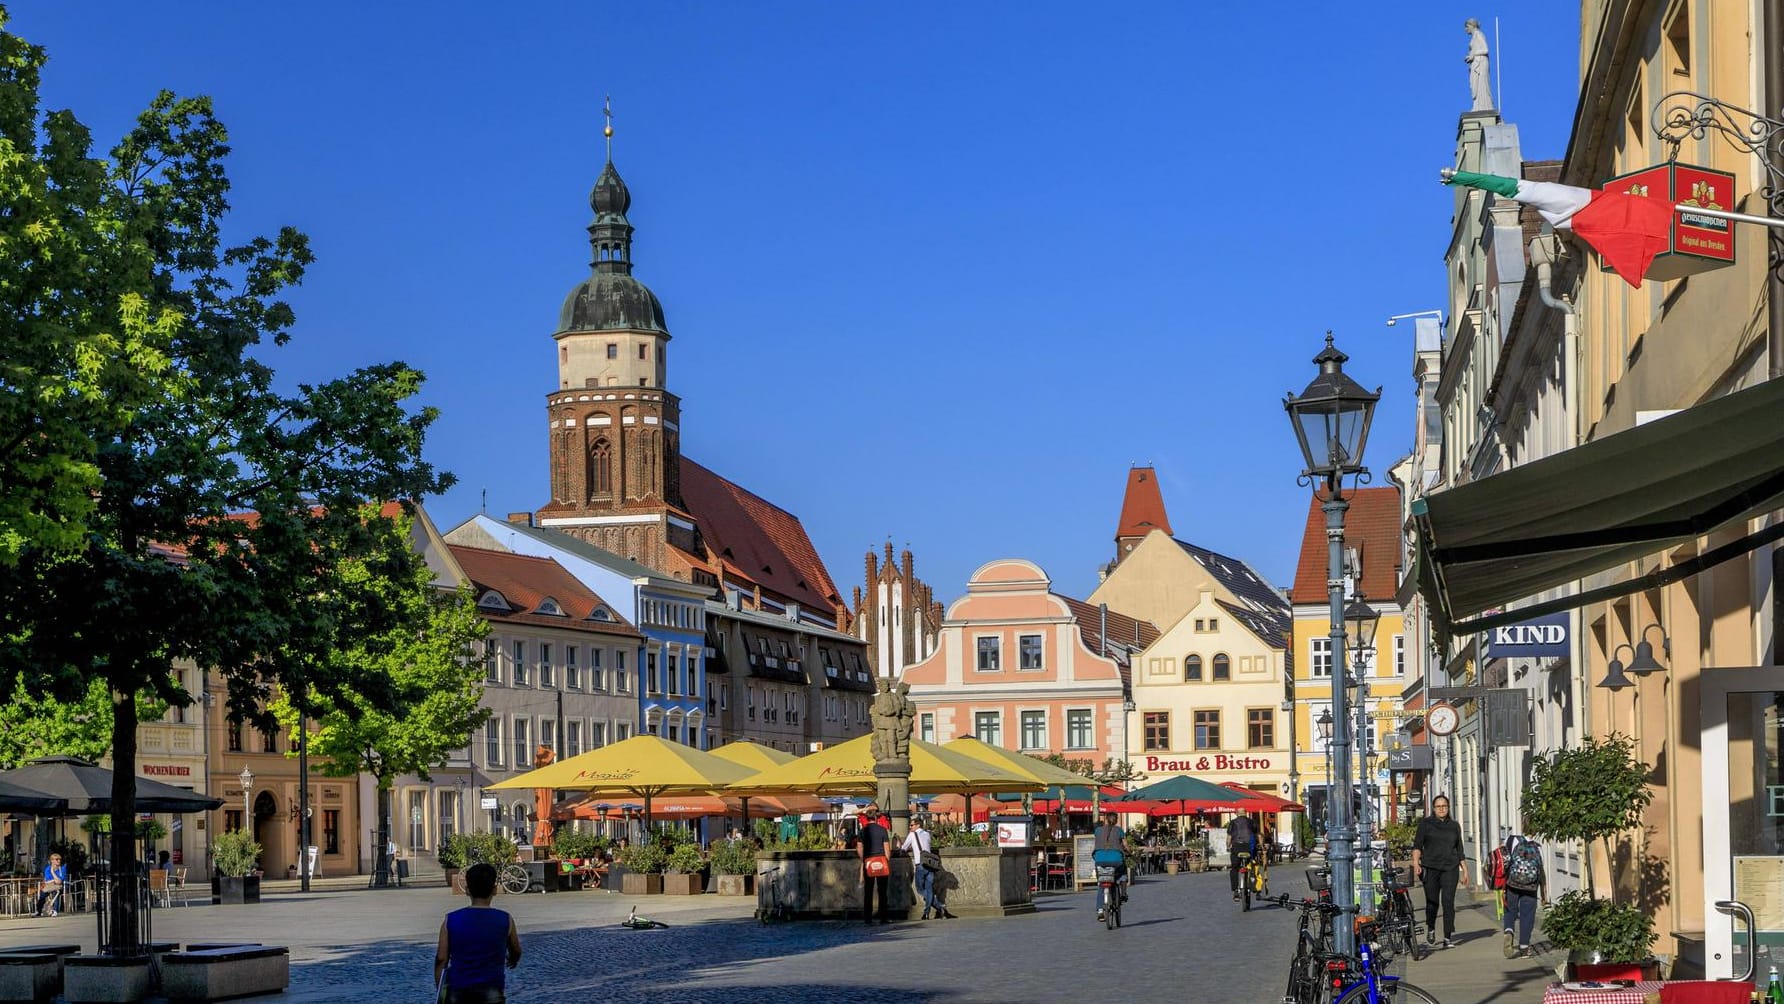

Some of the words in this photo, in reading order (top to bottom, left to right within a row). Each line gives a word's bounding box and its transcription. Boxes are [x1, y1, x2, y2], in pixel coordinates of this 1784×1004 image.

[1494, 625, 1566, 645] KIND
[1145, 756, 1192, 772] Brau
[1195, 756, 1211, 771] &
[1214, 754, 1271, 770] Bistro
